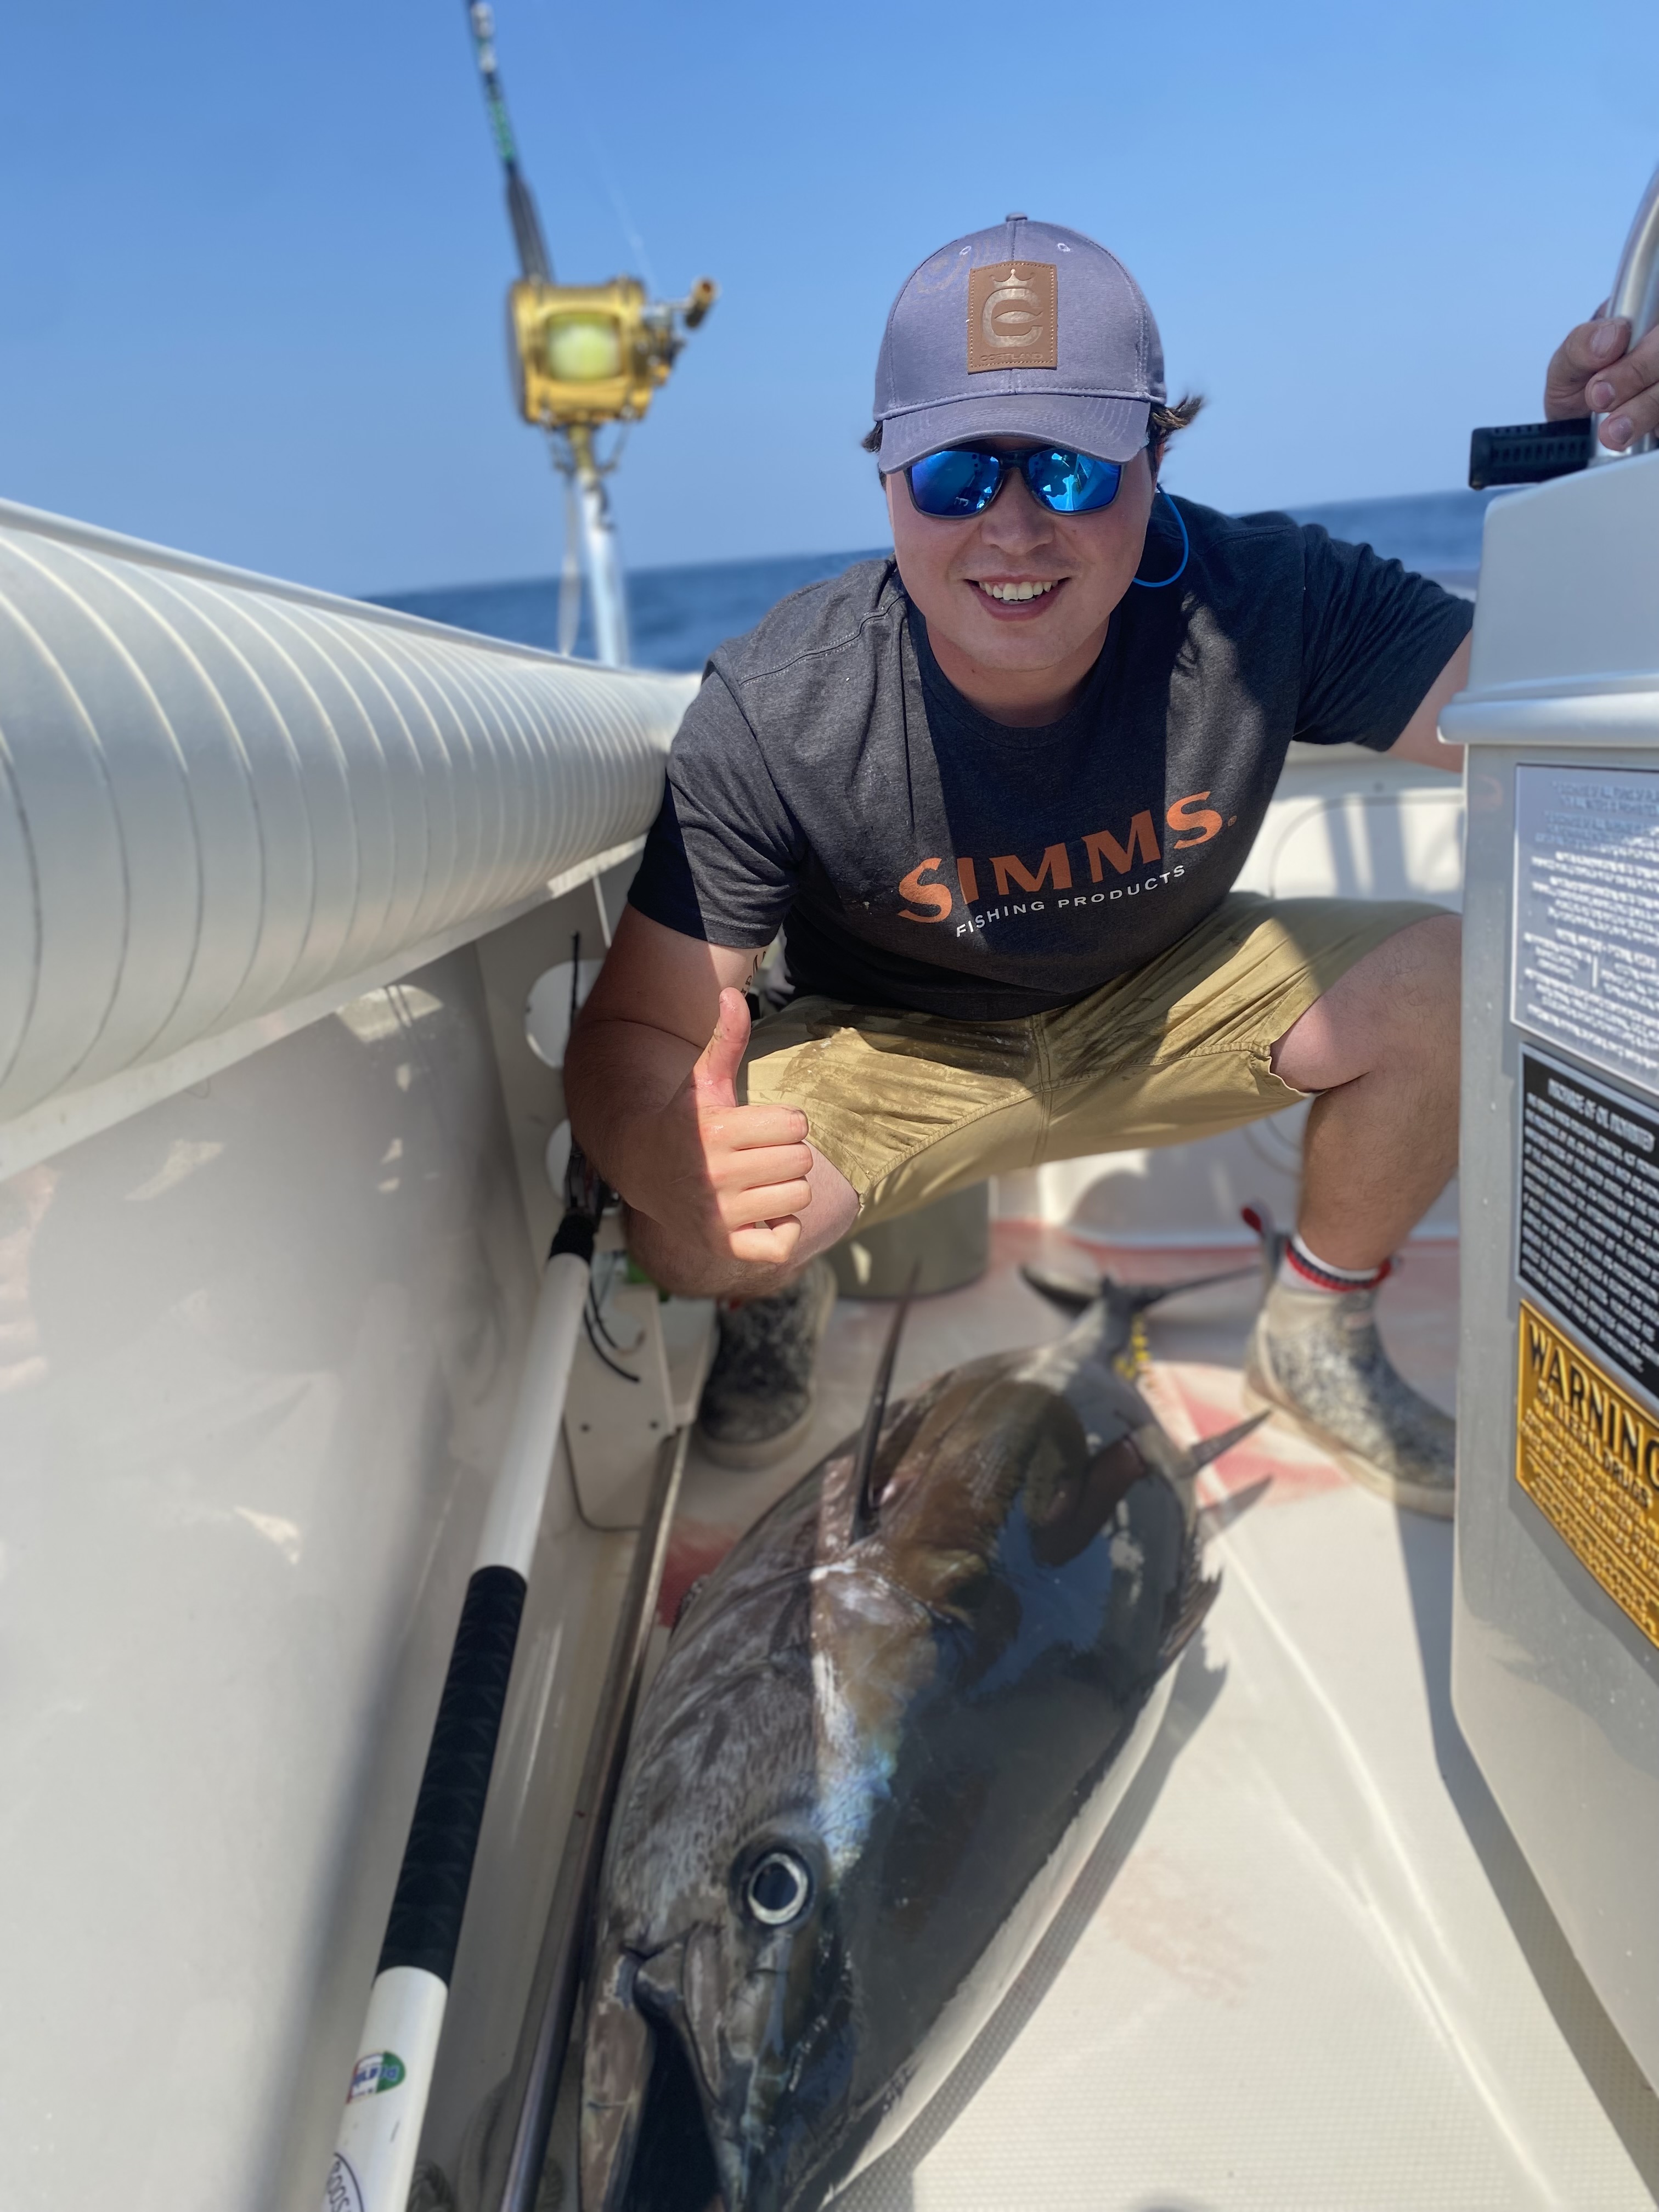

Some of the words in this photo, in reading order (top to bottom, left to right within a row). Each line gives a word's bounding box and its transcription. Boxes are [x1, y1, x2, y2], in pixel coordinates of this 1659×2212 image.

[980, 352, 1043, 362] CORTLAND
[897, 791, 1223, 923] SIMMS
[956, 900, 1045, 938] FISHING
[1058, 864, 1186, 909] PRODUCTS
